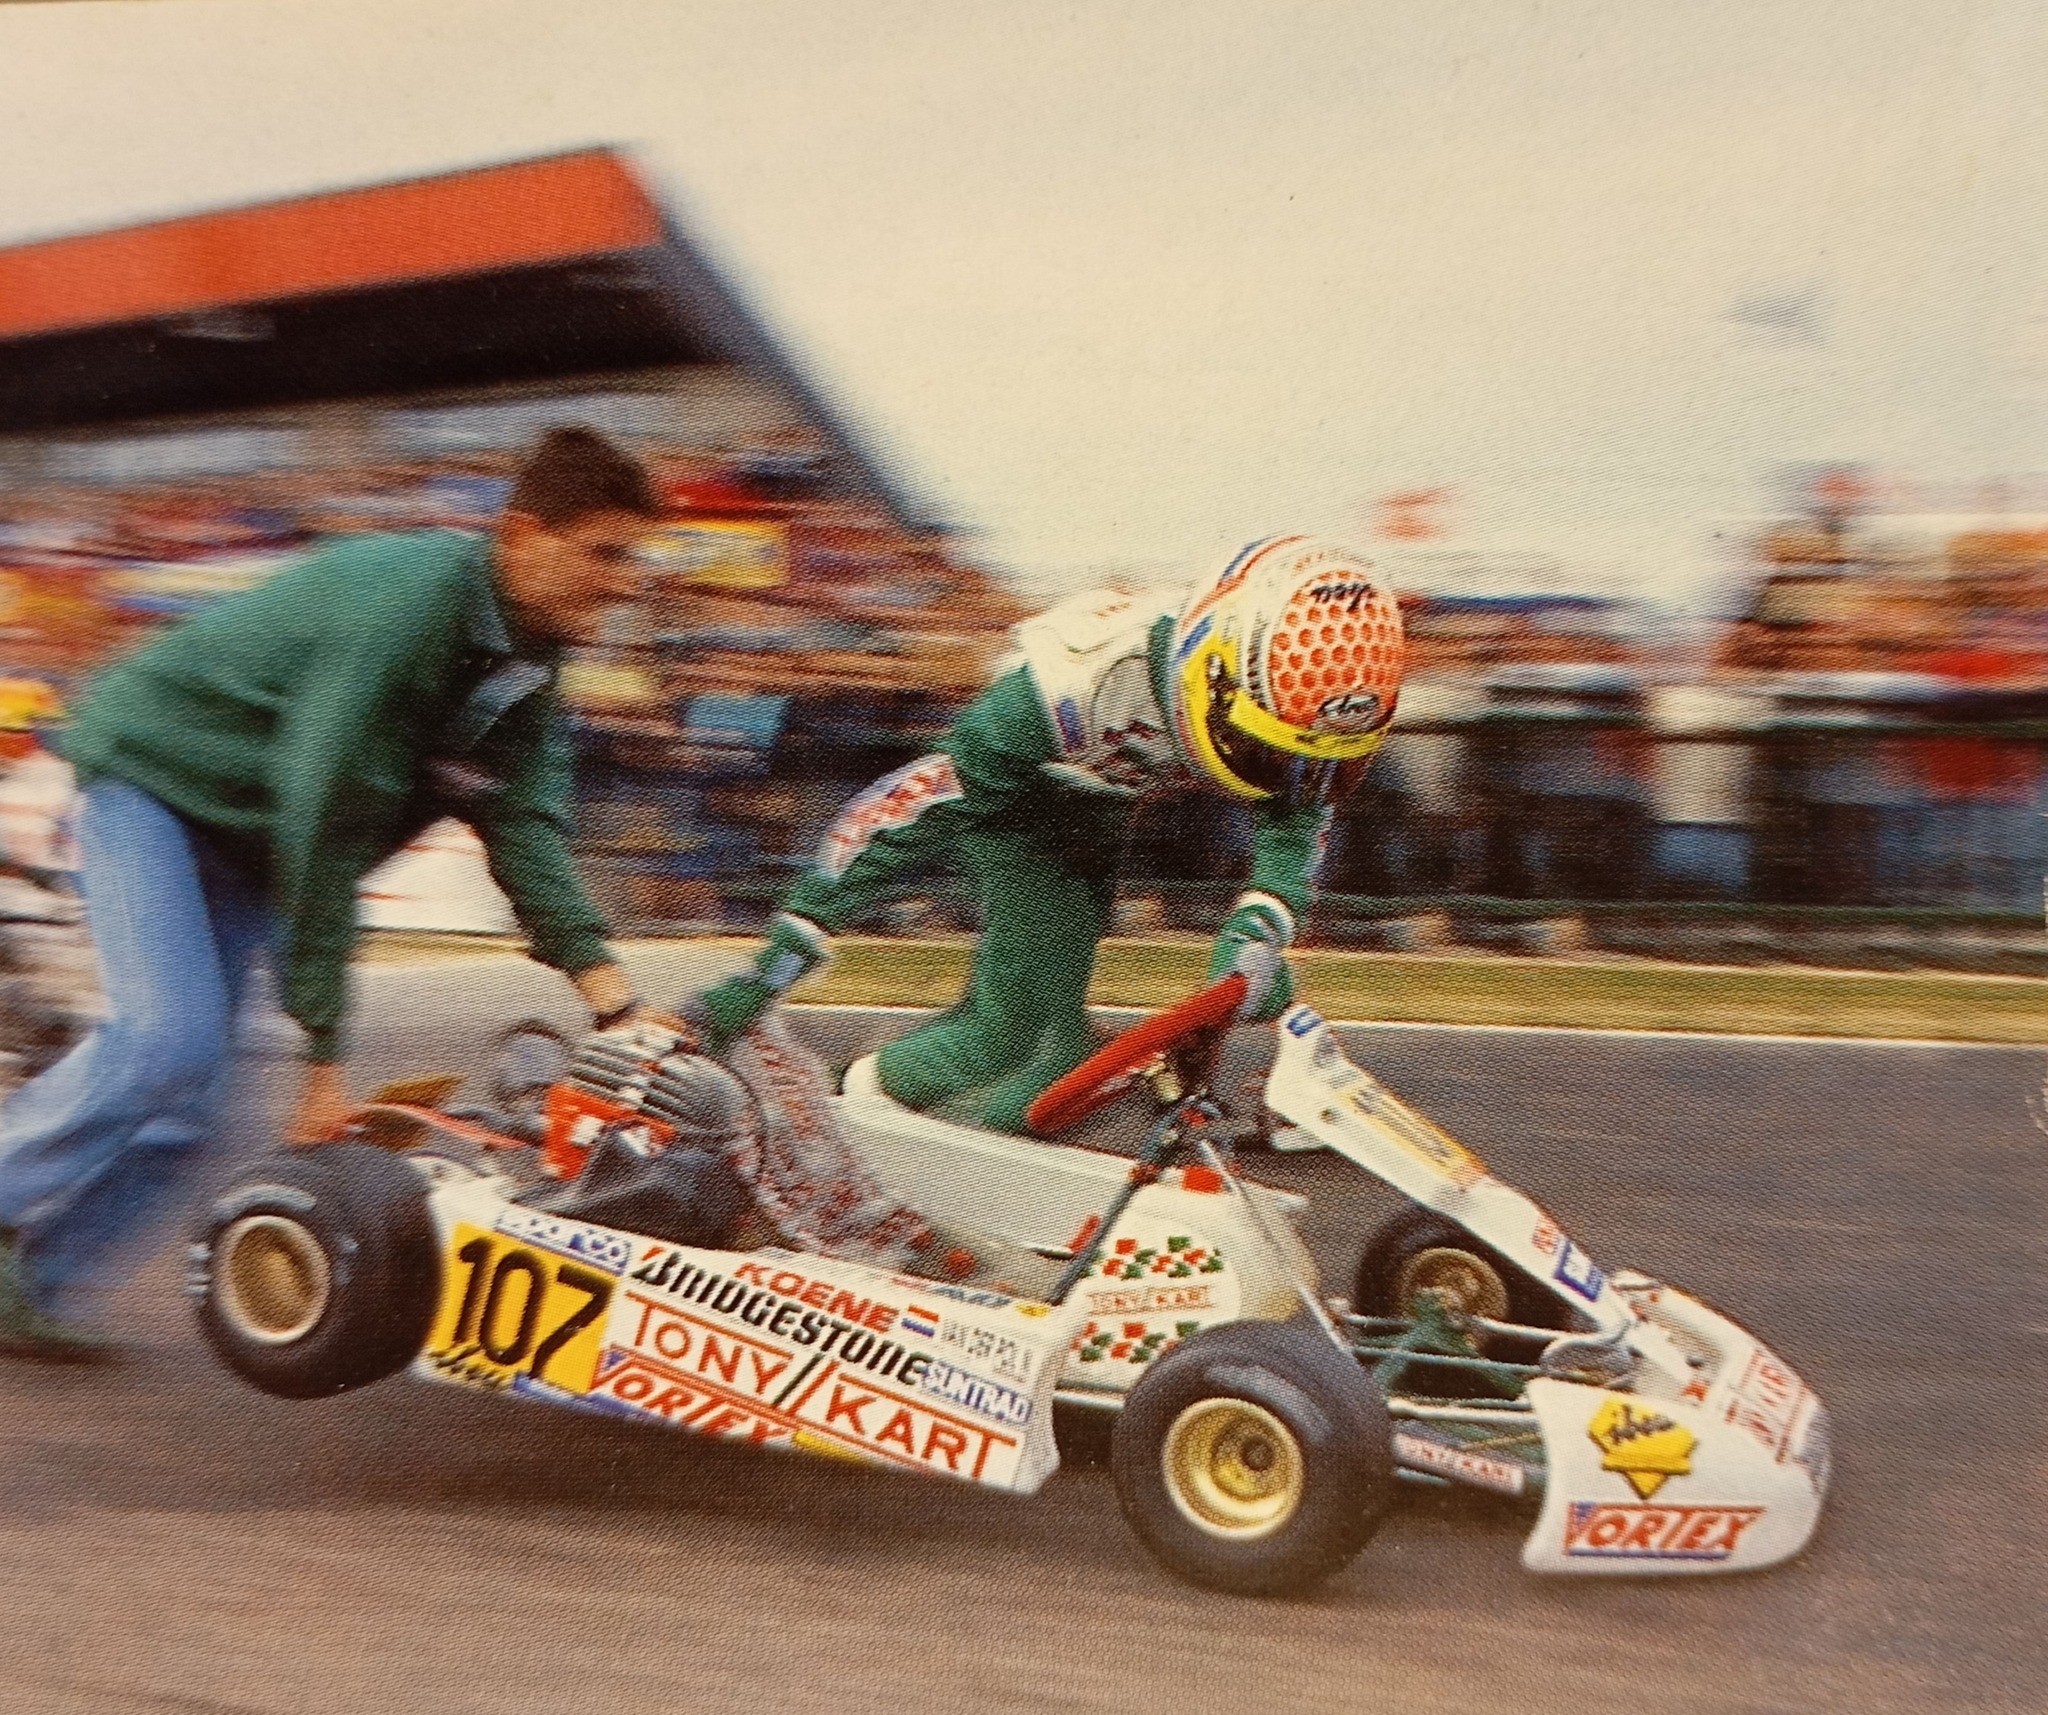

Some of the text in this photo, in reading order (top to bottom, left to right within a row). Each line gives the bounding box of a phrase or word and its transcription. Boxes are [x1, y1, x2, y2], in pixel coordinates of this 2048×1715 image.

[452, 1236, 615, 1382] 107
[630, 1247, 935, 1386] BRIDGESTONE
[735, 1261, 899, 1334] KOENE
[590, 1343, 790, 1445] VORTEX
[625, 1290, 1017, 1481] TONY KART
[1564, 1502, 1767, 1555] VORTEX
